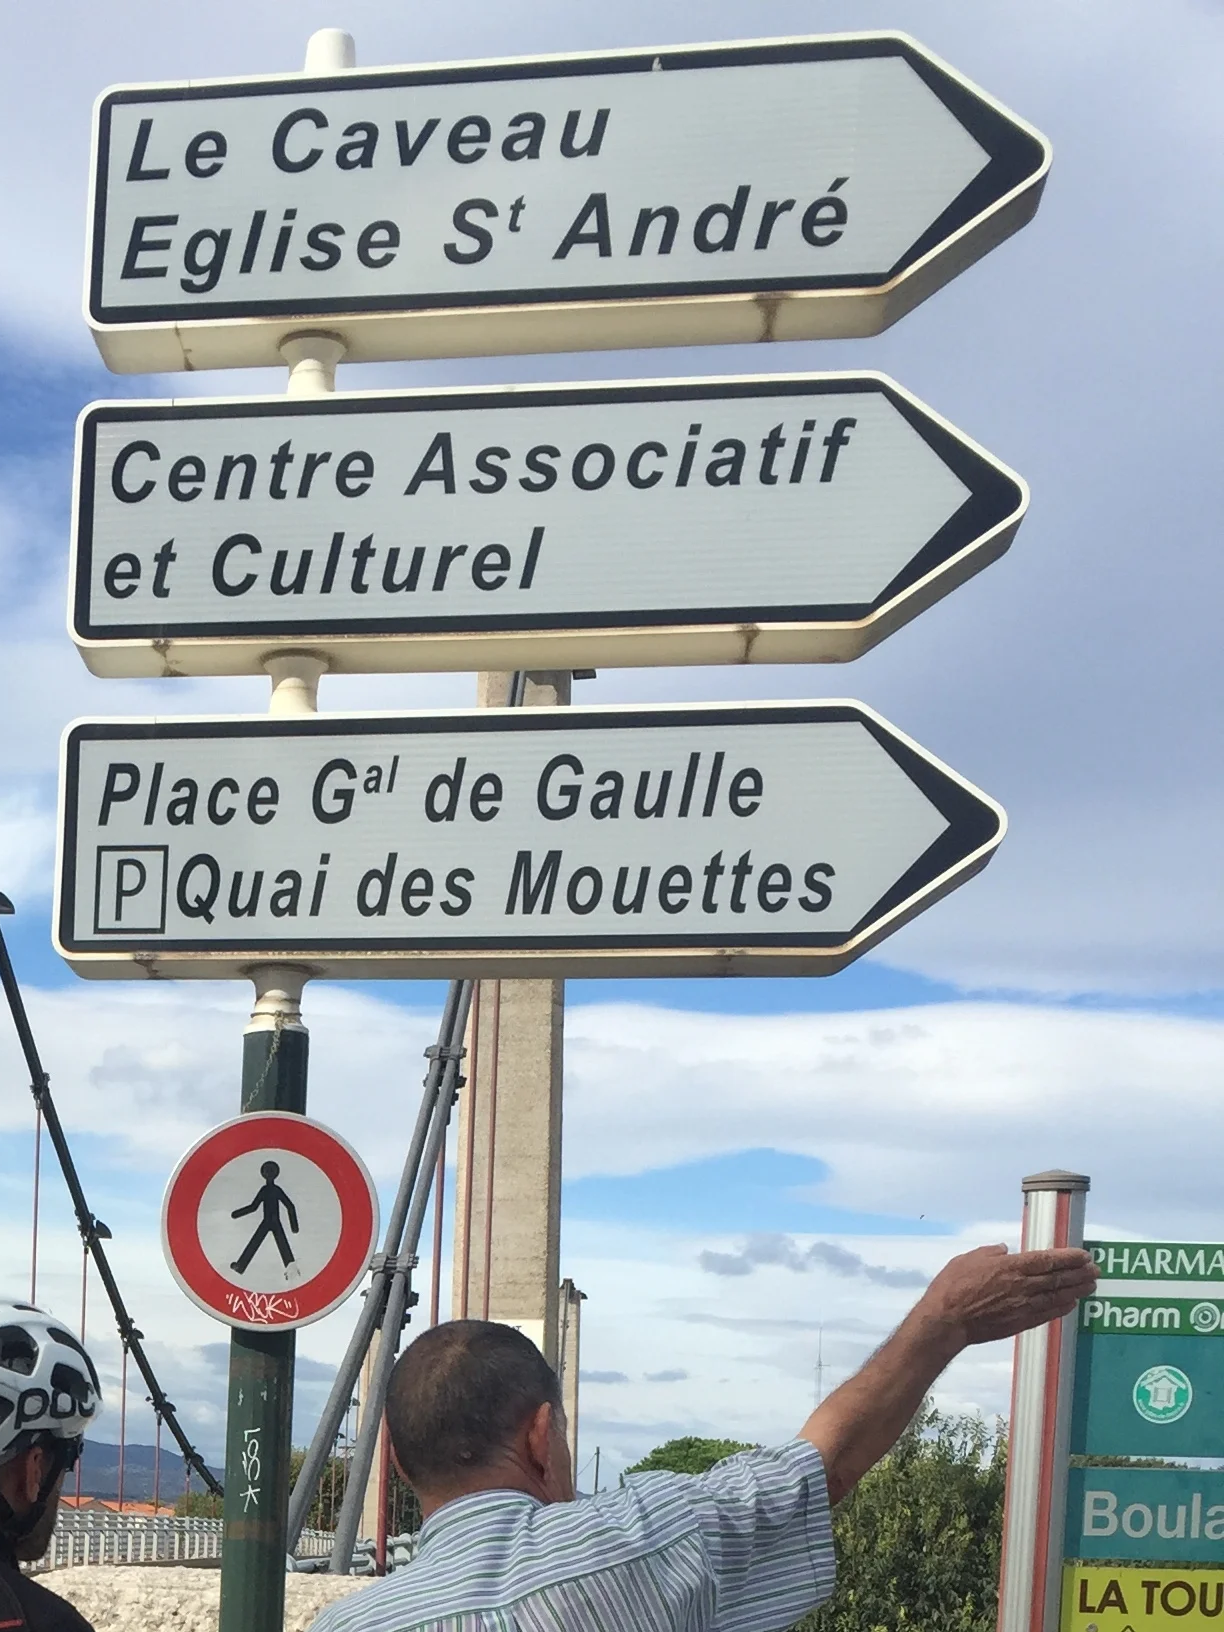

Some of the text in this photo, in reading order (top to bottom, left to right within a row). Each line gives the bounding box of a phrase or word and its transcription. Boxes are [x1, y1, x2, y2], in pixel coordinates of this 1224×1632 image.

[125, 107, 611, 182] Le Caveau
[120, 177, 849, 294] Eglise St André
[111, 417, 858, 504] Centre Associatif
[103, 526, 545, 600] et Culturel
[97, 751, 764, 827] Place Gal de Gaulle
[176, 852, 331, 925] Quai
[356, 852, 475, 917] des
[504, 848, 836, 916] Mouettes
[1090, 1247, 1224, 1276] PHARMA
[1083, 1301, 1181, 1330] Pharm
[1082, 1490, 1224, 1541] Boula
[1078, 1578, 1224, 1618] LA TOU
